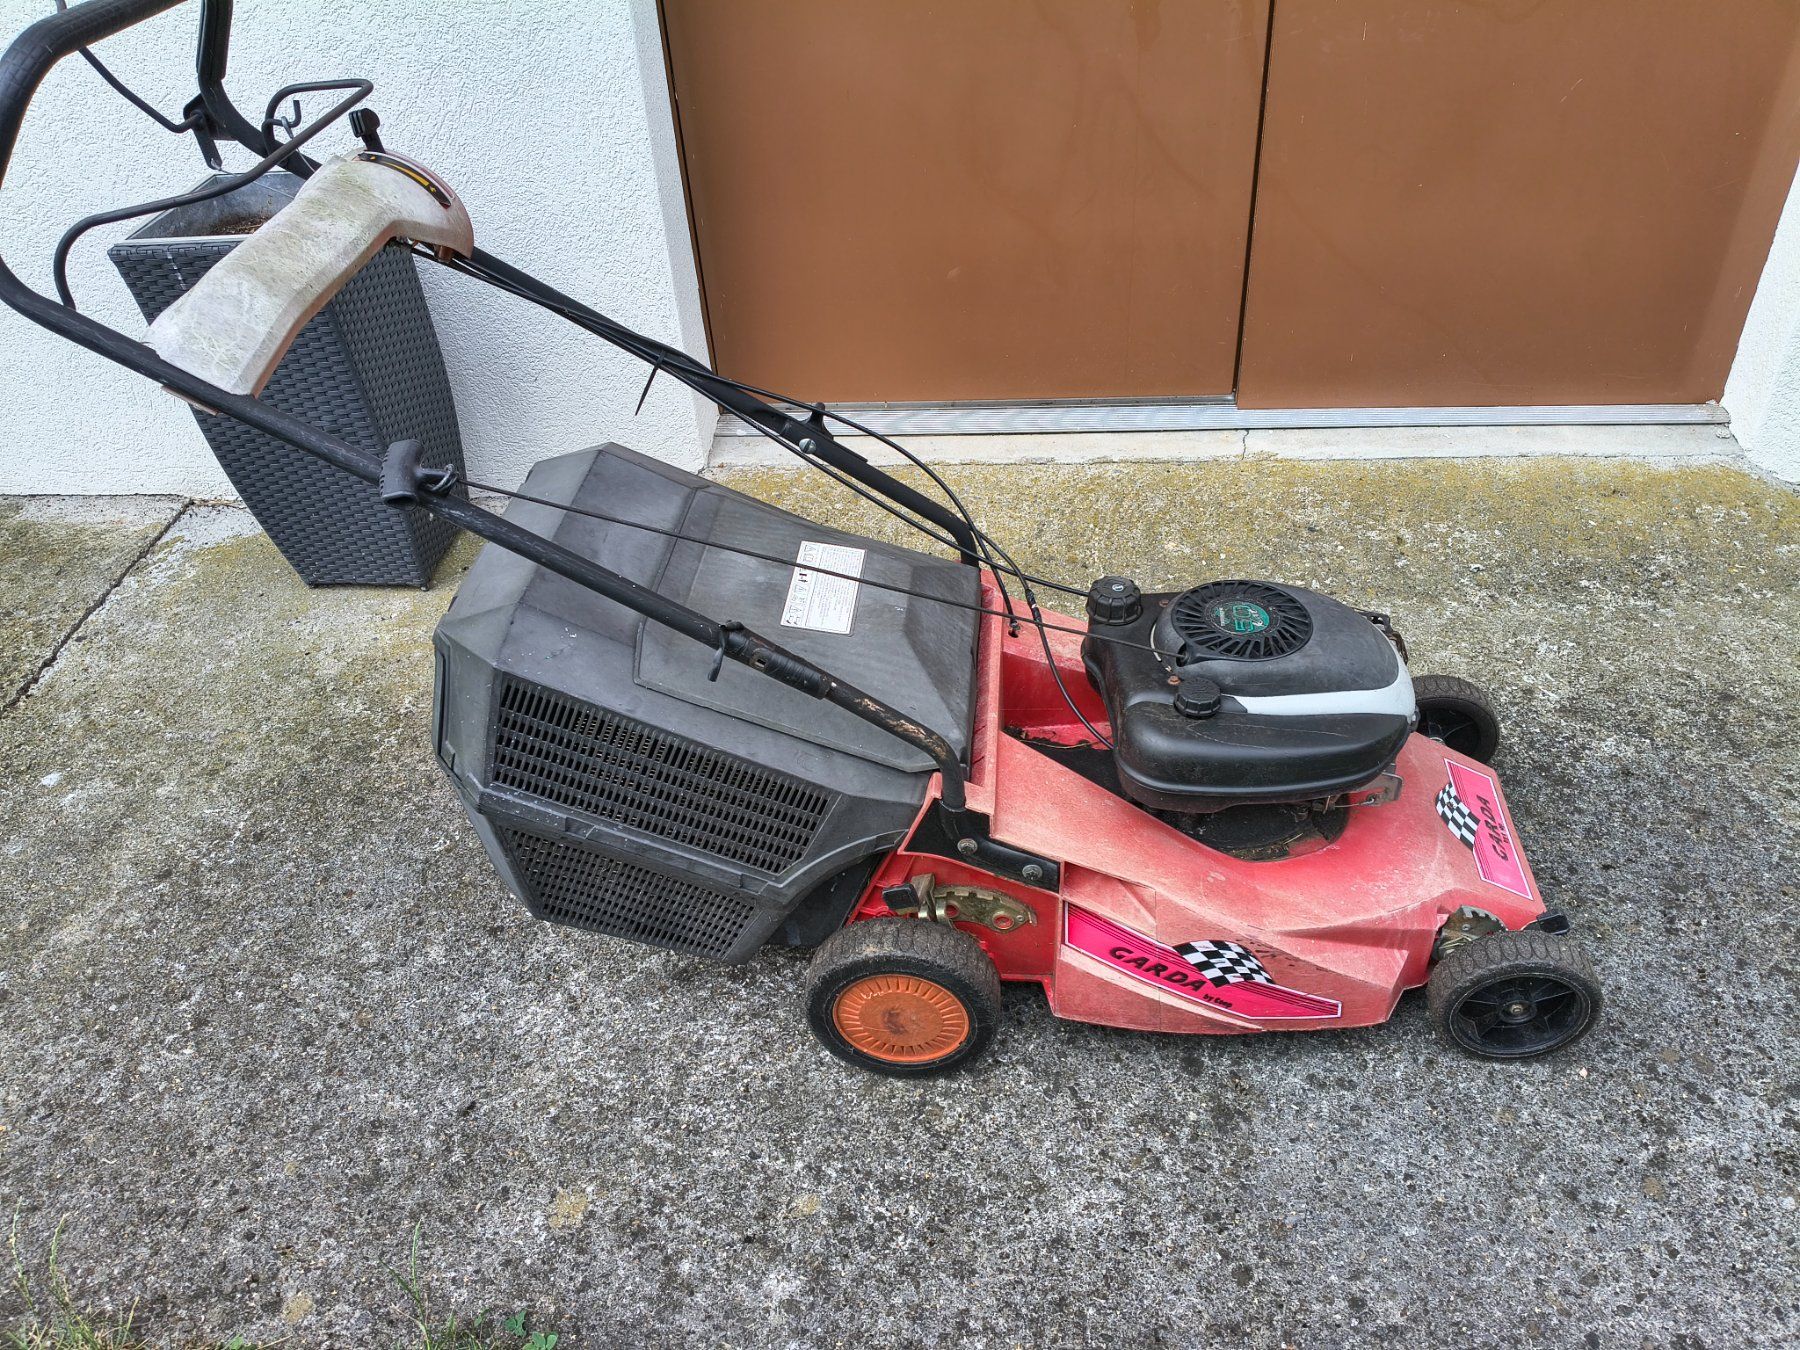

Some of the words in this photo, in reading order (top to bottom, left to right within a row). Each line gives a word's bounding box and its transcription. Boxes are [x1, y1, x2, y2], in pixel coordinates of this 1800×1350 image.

[1476, 794, 1508, 861] GARDA
[1109, 946, 1207, 991] GARDA
[1203, 993, 1214, 1002] by
